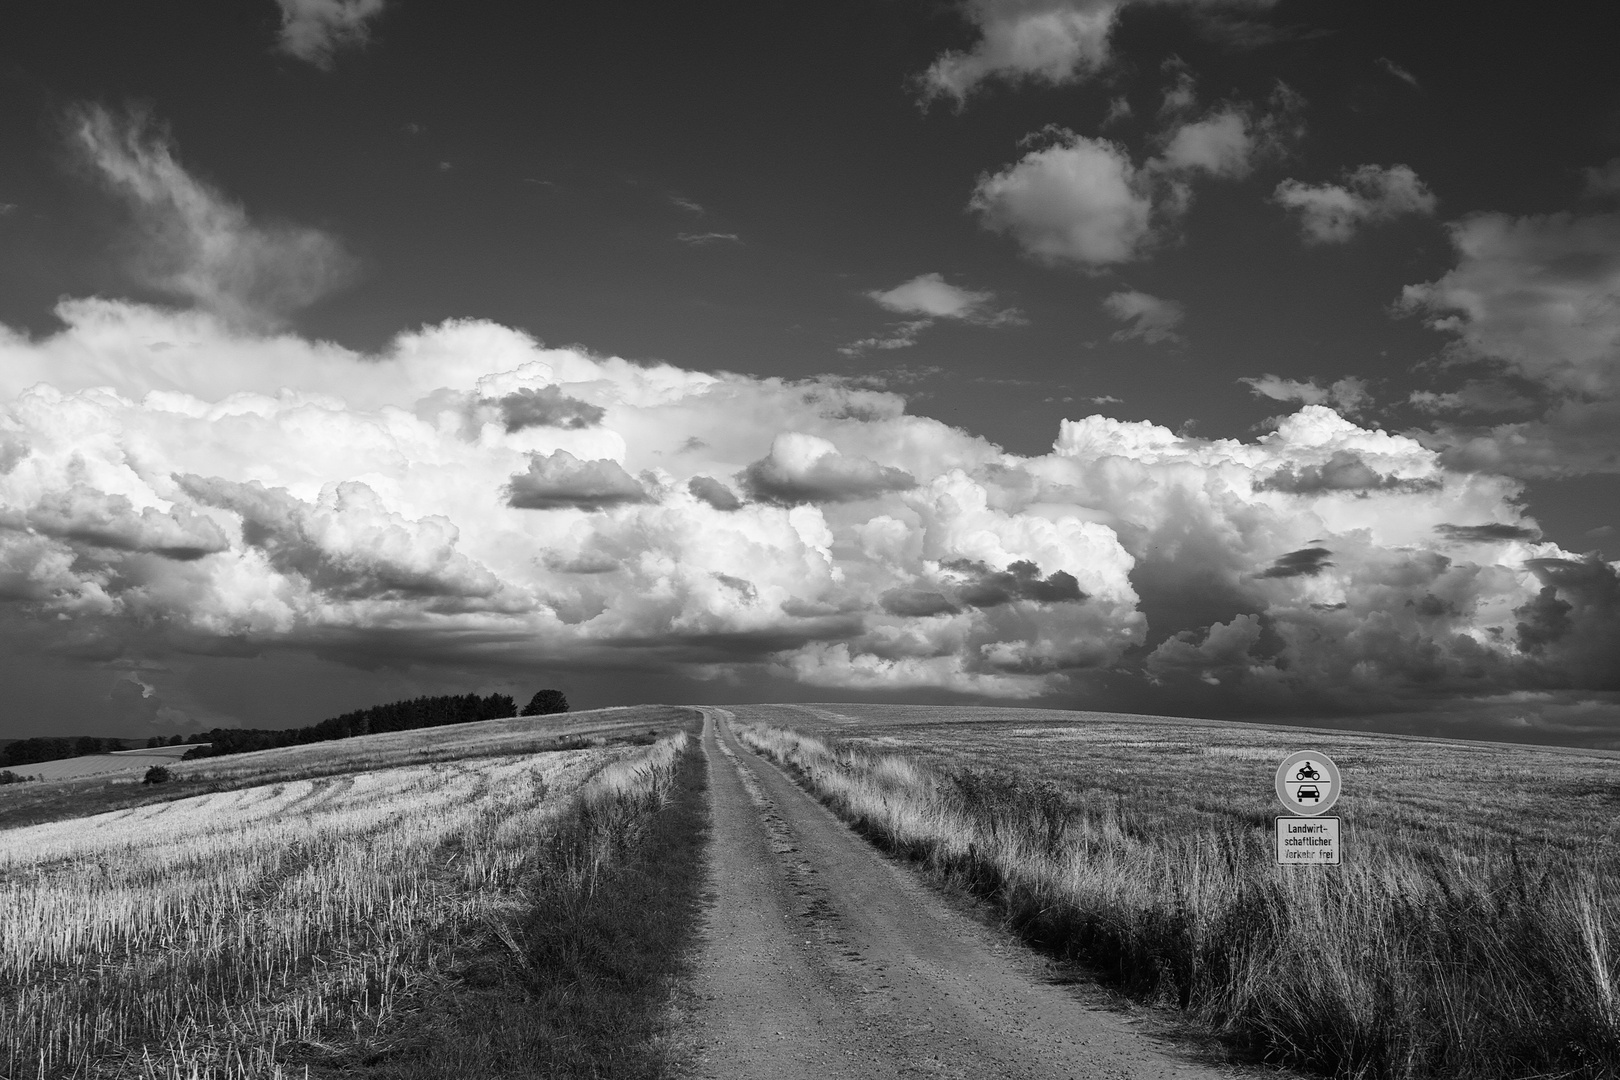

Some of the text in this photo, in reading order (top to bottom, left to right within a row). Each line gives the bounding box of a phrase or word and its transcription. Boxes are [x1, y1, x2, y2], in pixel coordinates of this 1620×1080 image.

[1288, 823, 1328, 834] Landwirt-
[1284, 836, 1332, 846] schaftlicher
[1319, 849, 1333, 859] frei
